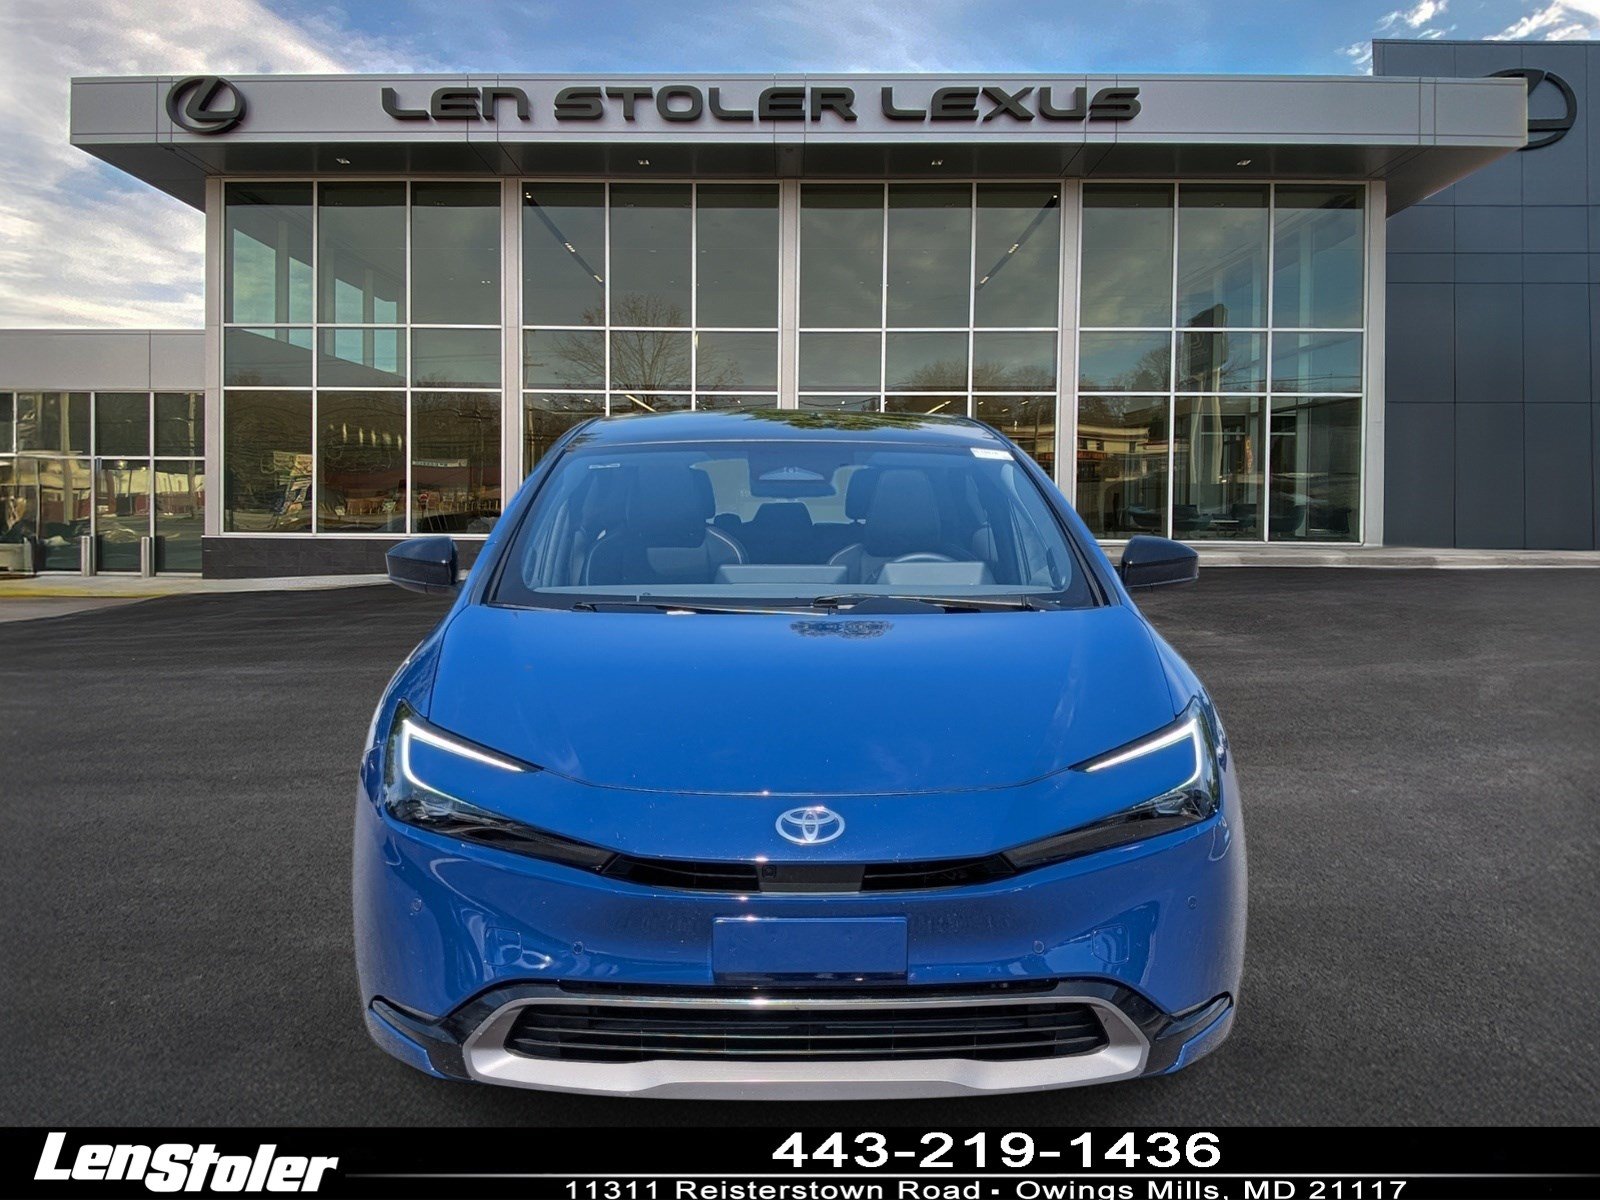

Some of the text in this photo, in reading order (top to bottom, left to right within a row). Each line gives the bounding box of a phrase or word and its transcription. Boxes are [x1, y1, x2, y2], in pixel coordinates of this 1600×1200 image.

[381, 85, 1142, 122] LEN STOLER LEXUS
